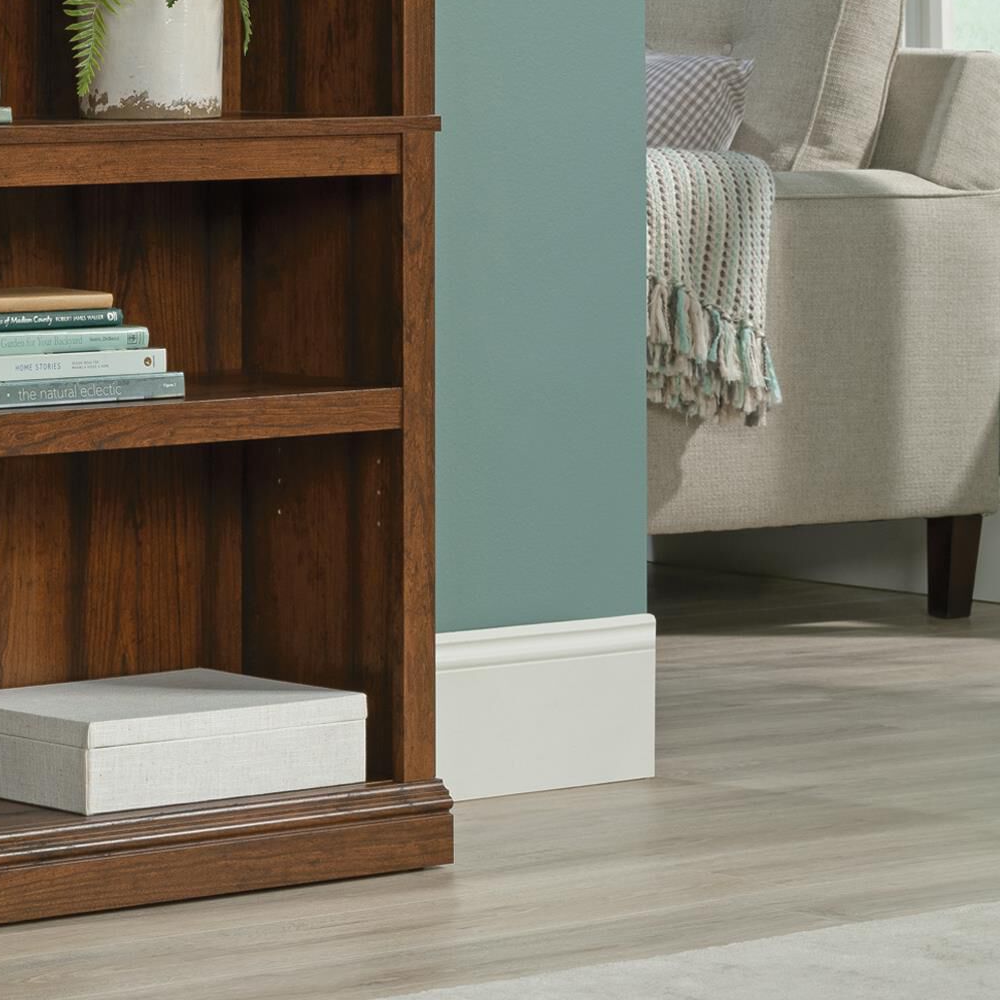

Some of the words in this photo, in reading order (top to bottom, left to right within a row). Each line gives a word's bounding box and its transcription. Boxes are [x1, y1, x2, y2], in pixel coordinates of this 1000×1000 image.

[3, 317, 10, 327] of
[33, 315, 53, 326] County
[1, 338, 25, 349] Garden
[36, 336, 53, 346] Your
[54, 334, 84, 346] Backyard
[15, 363, 33, 371] HOME
[35, 362, 62, 371] STORIES
[18, 387, 37, 401] the
[40, 382, 78, 399] natural
[80, 382, 122, 398] eclectic
